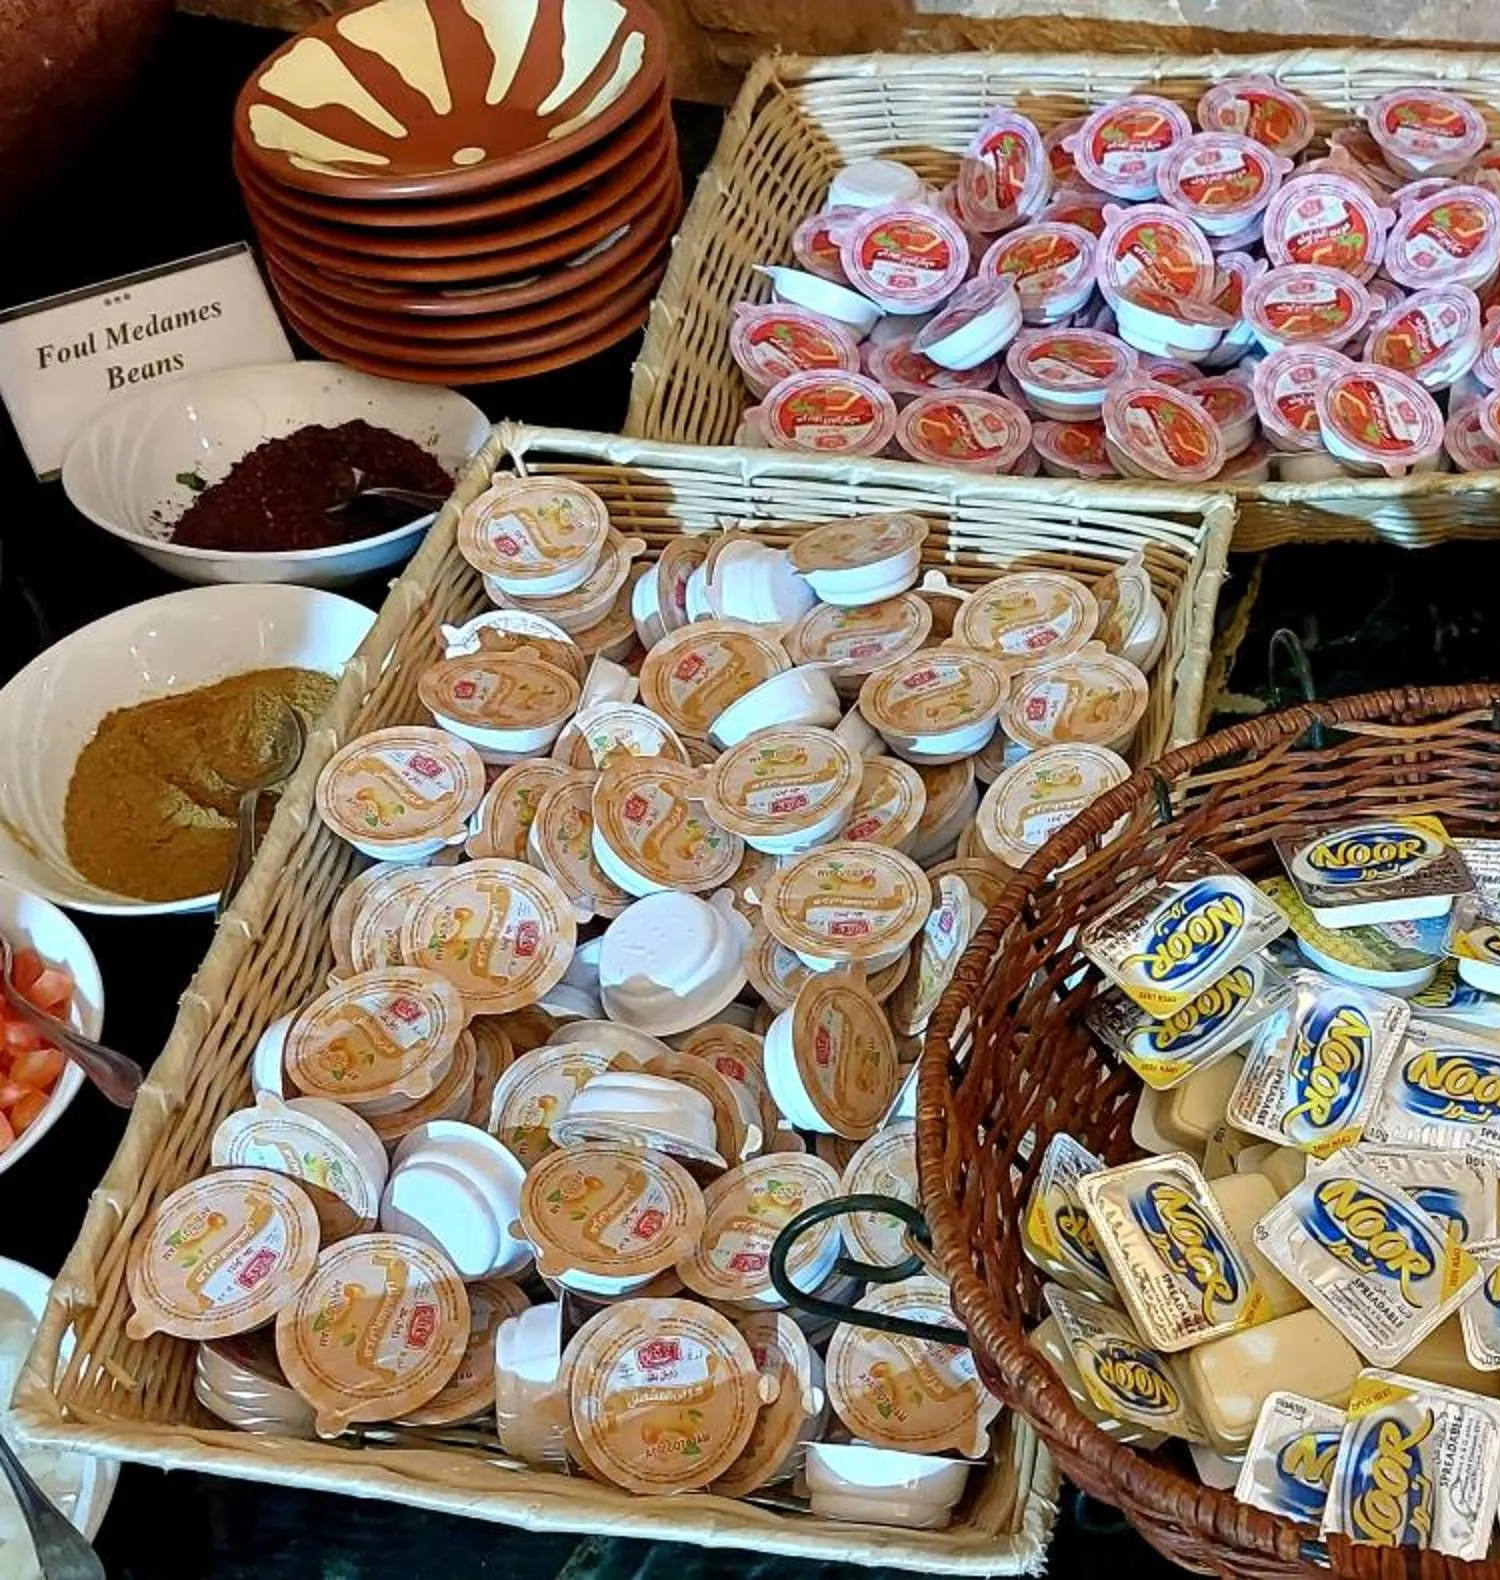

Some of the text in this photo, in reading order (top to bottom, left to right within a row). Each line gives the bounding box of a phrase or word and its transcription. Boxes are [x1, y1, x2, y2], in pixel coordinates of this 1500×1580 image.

[36, 301, 223, 369] Foul Medames
[106, 352, 185, 390] Beans
[1310, 839, 1444, 868] NOOR
[1118, 896, 1243, 981] NOOR
[1281, 1008, 1372, 1133] NOOR
[1152, 1185, 1234, 1324] NOOR
[1318, 1180, 1433, 1308] NOOR
[1350, 1277, 1404, 1330] SPREADABLE
[1440, 1413, 1463, 1488] SPREADABLE
